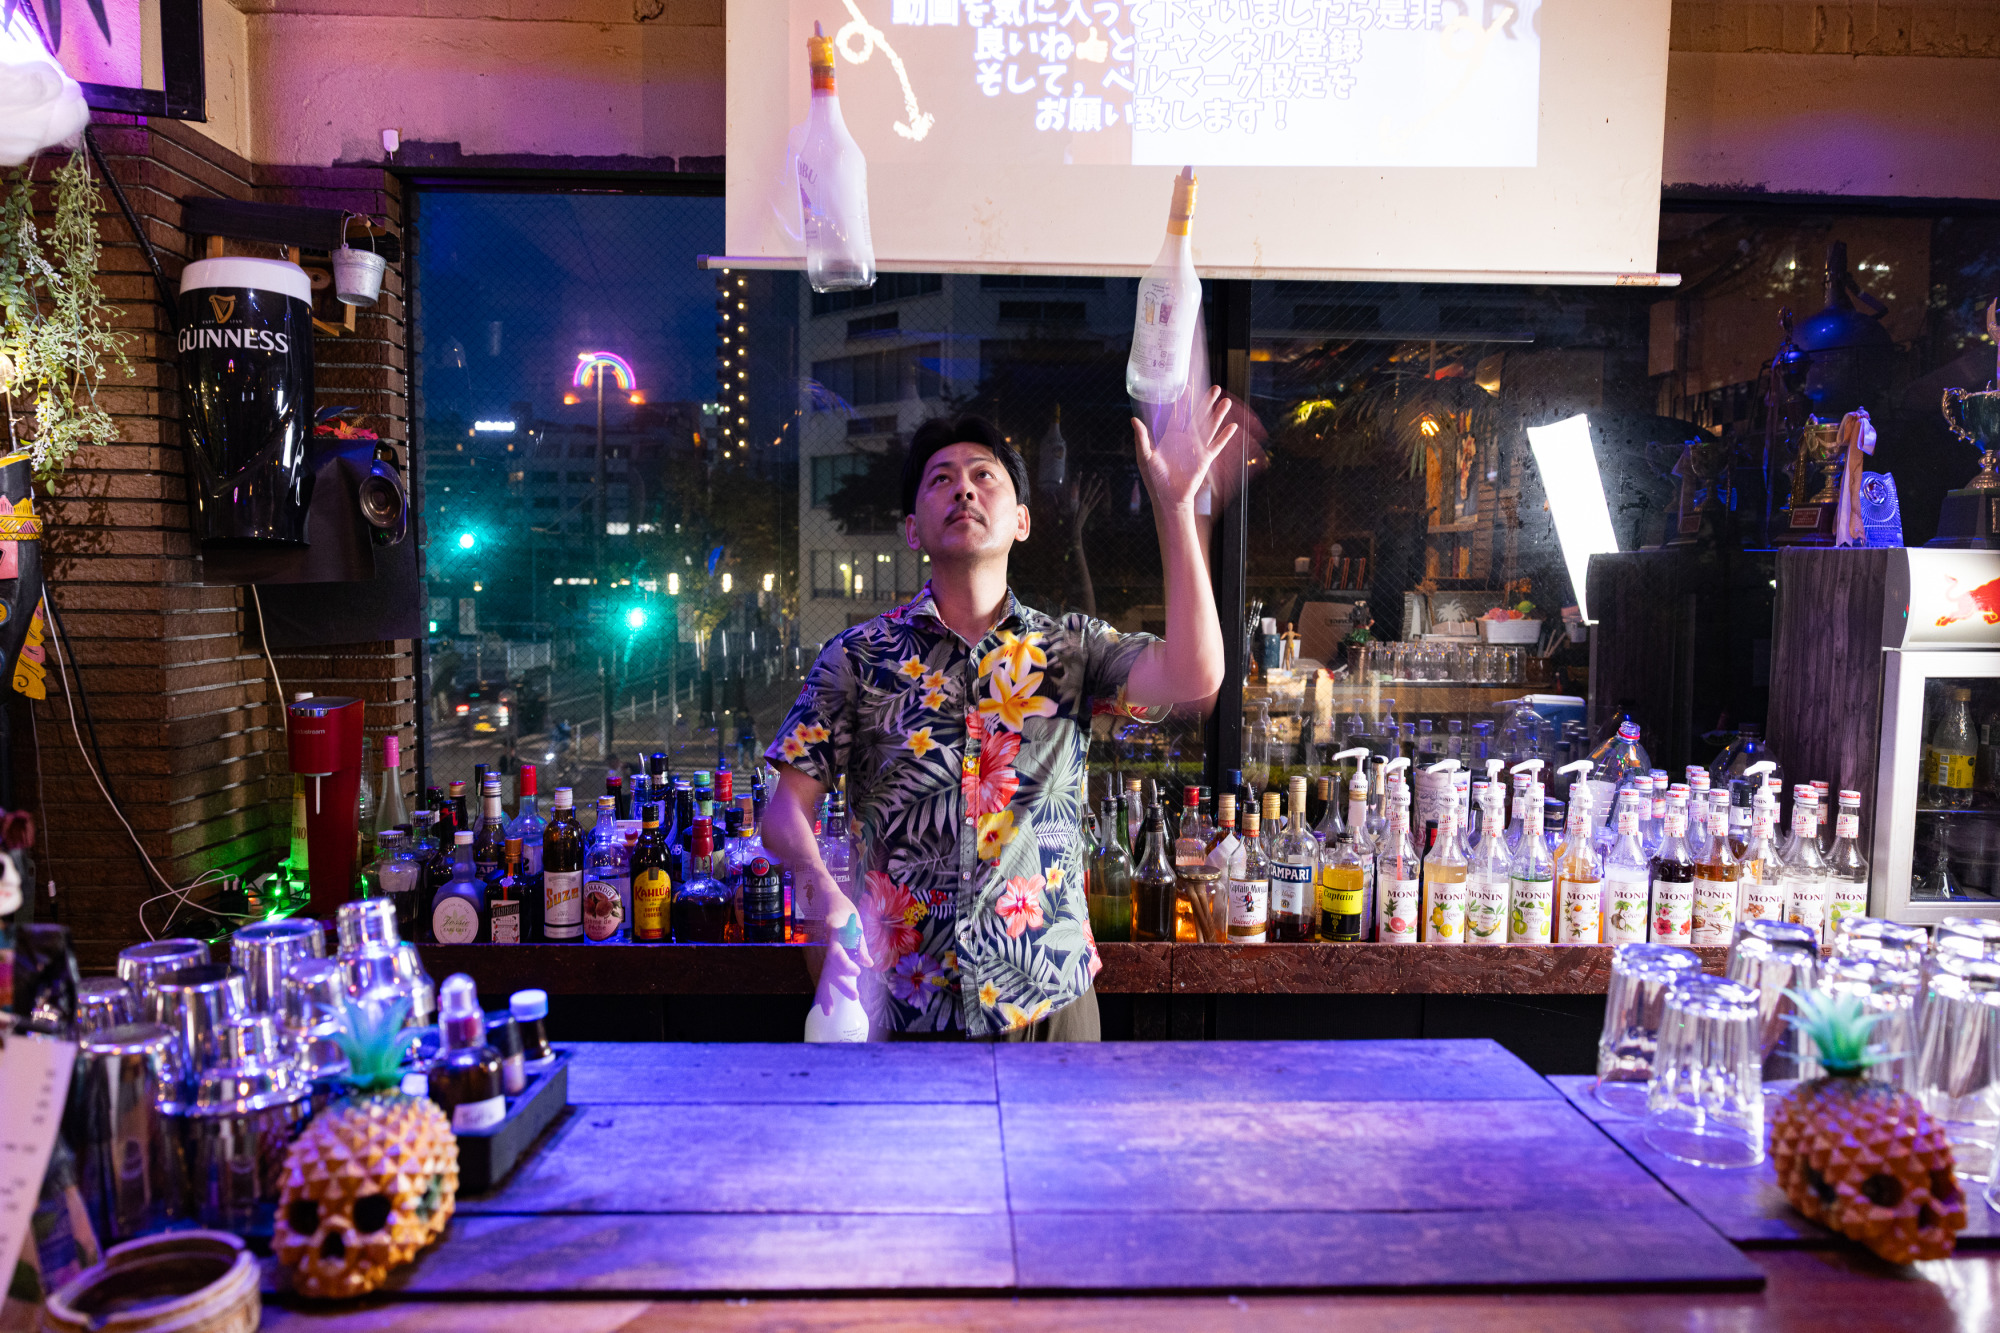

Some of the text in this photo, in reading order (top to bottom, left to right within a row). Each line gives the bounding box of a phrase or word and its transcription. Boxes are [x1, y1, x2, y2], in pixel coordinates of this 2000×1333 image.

[178, 328, 289, 353] GUINNESS
[546, 887, 579, 911] Suze
[635, 885, 670, 902] KAHLÚA
[1323, 889, 1354, 902] Captain
[1695, 887, 1733, 899] MONIN
